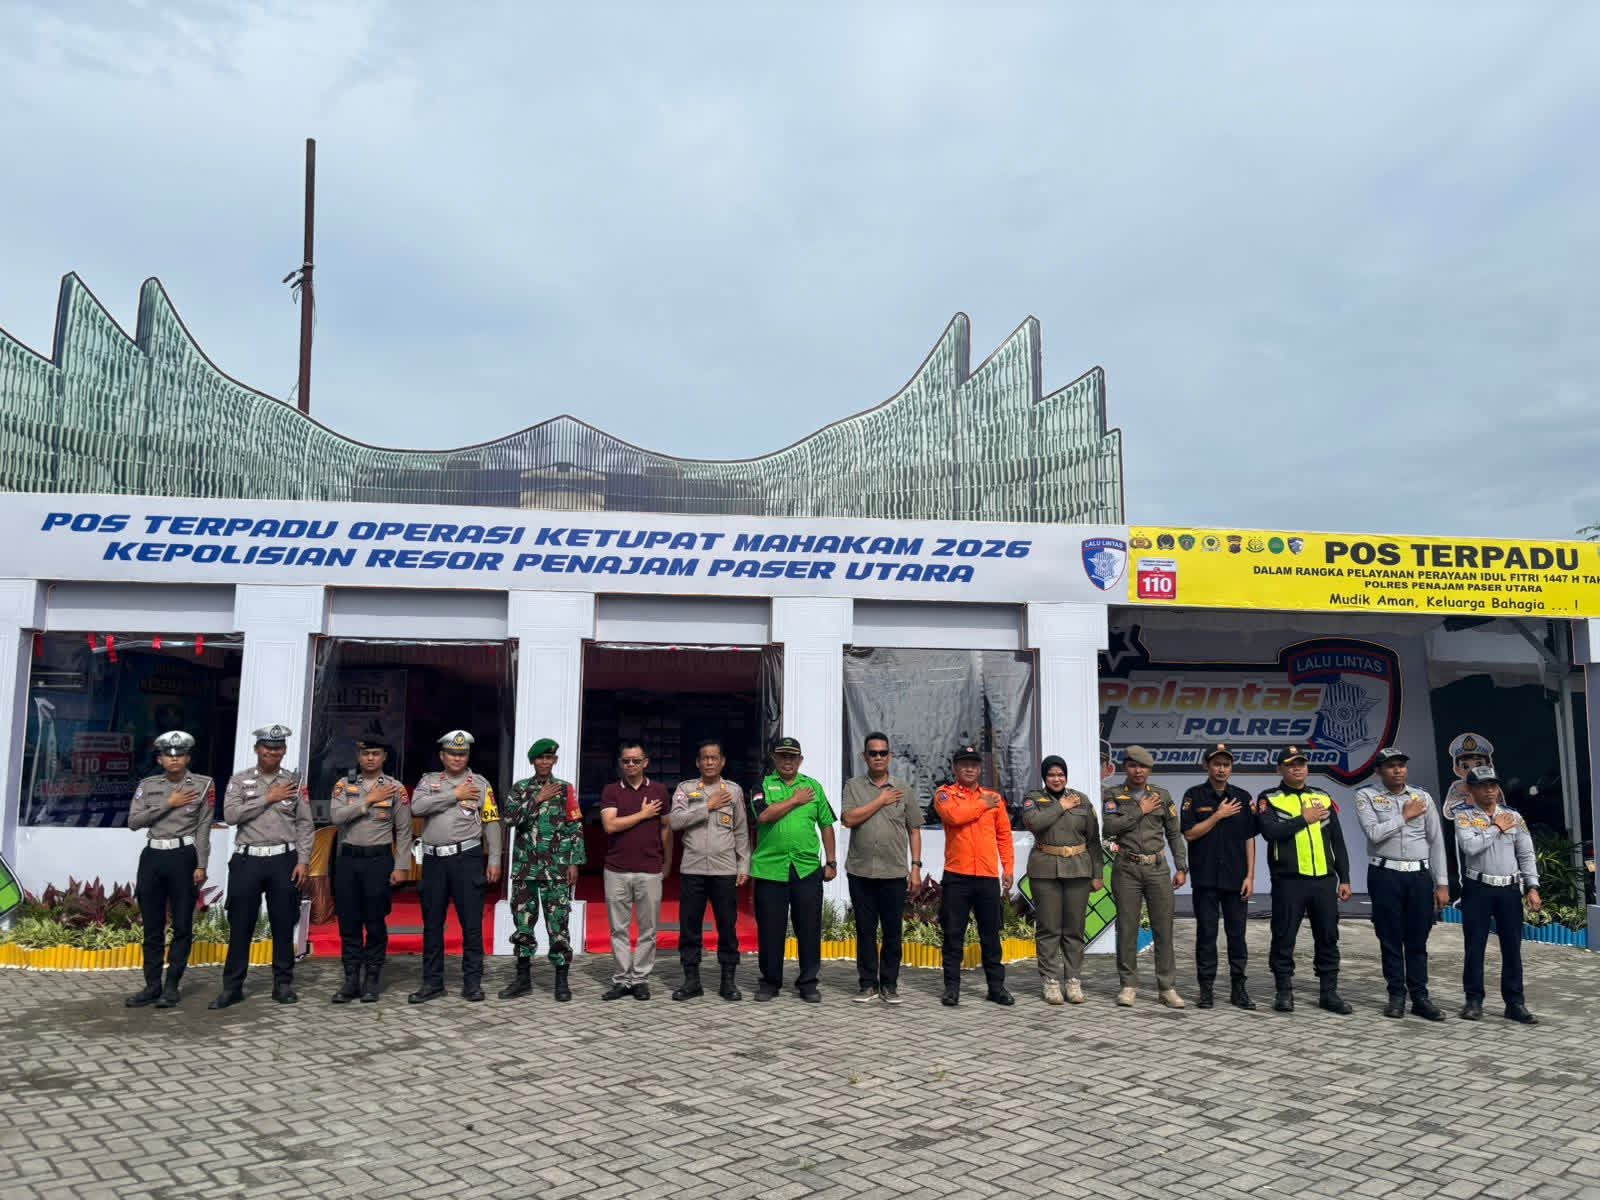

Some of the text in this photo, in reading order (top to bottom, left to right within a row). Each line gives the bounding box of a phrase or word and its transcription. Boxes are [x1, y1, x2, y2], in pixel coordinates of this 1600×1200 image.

[40, 512, 1033, 559] POS TERPADU OPERASI KETUPAT MAHAKAM 2026
[103, 542, 975, 583] KEPOLISIAN RESOR PENAJAM PASER UTARA
[1325, 541, 1579, 570] POS TERPADU
[1143, 576, 1172, 592] 110
[1253, 565, 1292, 575] DALAM
[1295, 567, 1344, 577] RANGKA
[1347, 568, 1414, 579] PELAYANAN
[1418, 570, 1477, 581] PERAYAAN
[1480, 572, 1506, 582] IDUL
[1510, 573, 1539, 583] FITRI
[1543, 574, 1568, 583] 1447
[1571, 575, 1580, 584] H
[1364, 580, 1543, 593] POLRES PENAJAM PASER UTARA
[1329, 593, 1370, 605] Mudik
[1377, 595, 1418, 608] Aman,
[1426, 596, 1485, 611] Keluarga
[1491, 597, 1545, 613] Bahagia
[1296, 655, 1383, 673] LALU LINTAS
[1100, 680, 1322, 713] Polantas
[1183, 717, 1312, 736] POLRES
